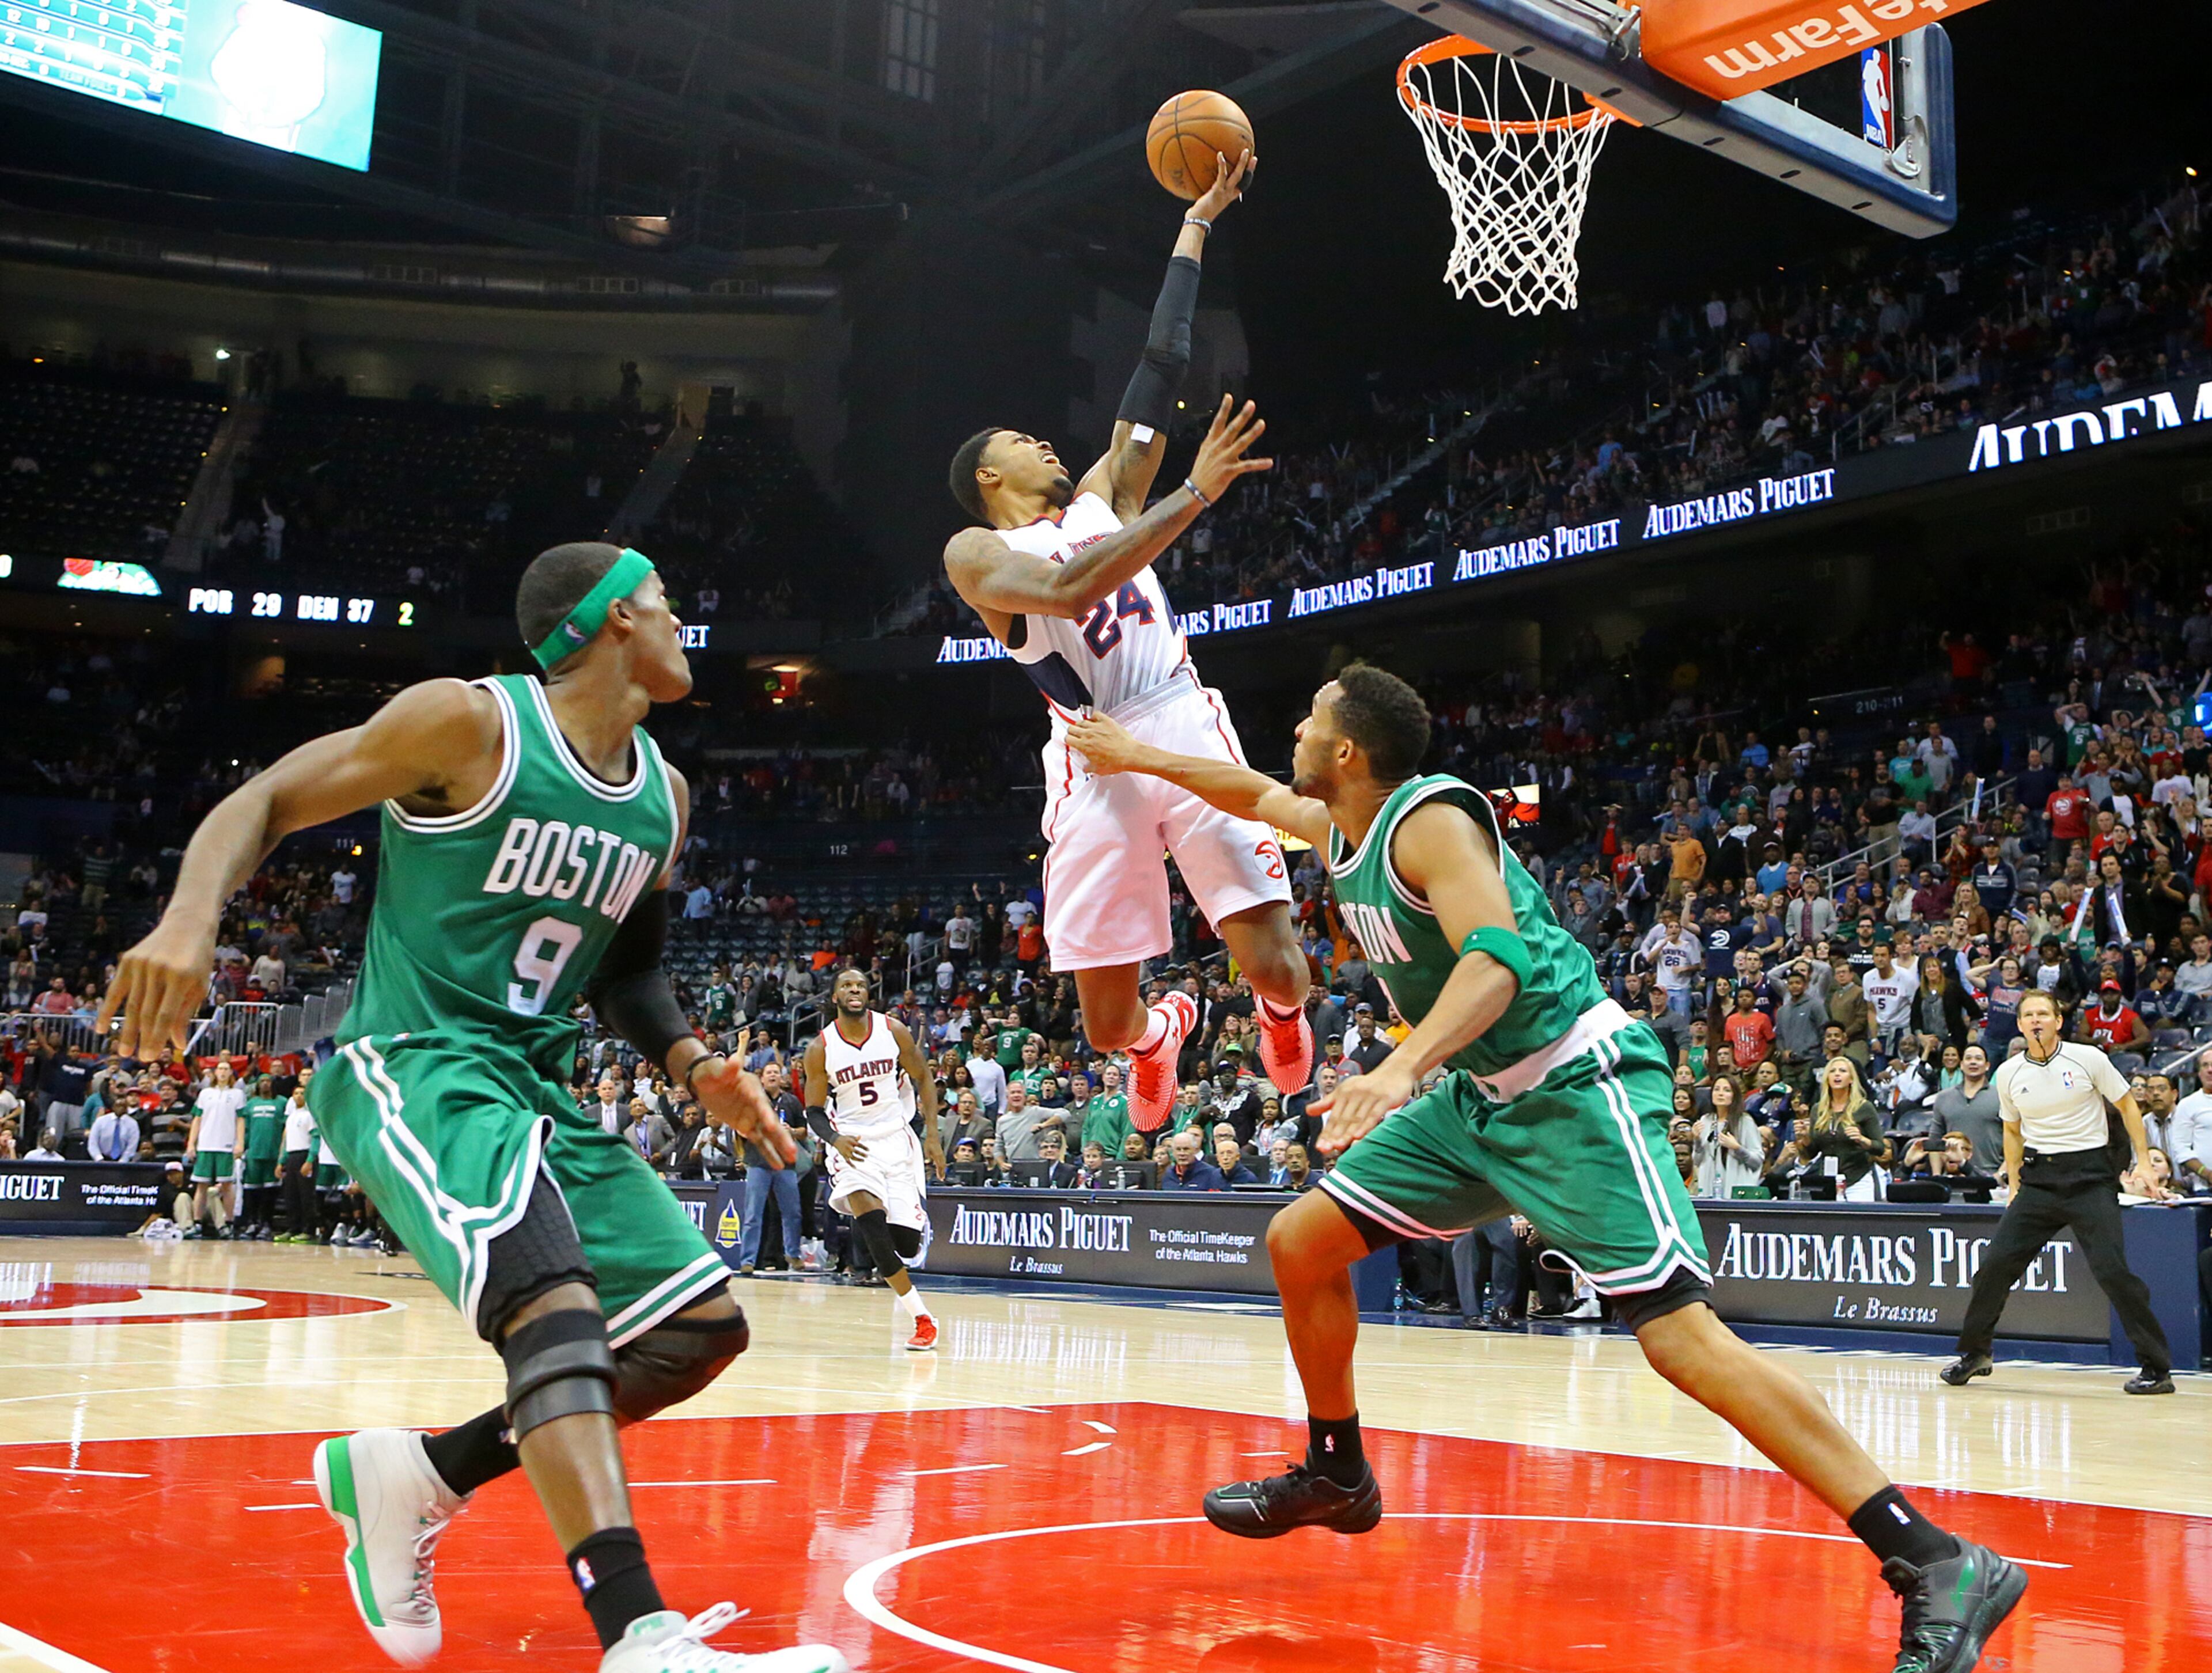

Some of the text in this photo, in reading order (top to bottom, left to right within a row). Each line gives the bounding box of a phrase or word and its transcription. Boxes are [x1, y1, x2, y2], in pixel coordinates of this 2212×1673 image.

[1642, 468, 1835, 538] AUDEMARS PIGUET
[1452, 518, 1620, 582] AUDEMARS PIGUET
[1288, 561, 1435, 619] AUDEMARS PIGUET
[188, 588, 233, 614] POR
[297, 594, 340, 621] DEN
[398, 602, 414, 626] 2
[1073, 578, 1157, 661] 24
[1213, 599, 1272, 632] PIGUET
[830, 844, 847, 855] 112
[482, 818, 657, 924] BOSTON
[507, 916, 583, 1016] 9
[1869, 986, 1898, 996] HAWKS
[1878, 998, 1886, 1010] 5
[1002, 1037, 1012, 1048] 9
[859, 1081, 878, 1106] 5
[81, 1184, 99, 1194] The
[949, 1204, 1132, 1251] AUDEMARS PIGUET
[1149, 1229, 1256, 1249] The Official TimeKeeper
[1009, 1255, 1063, 1274] Le Brassus
[1155, 1247, 1249, 1264] of the Atlanta Hawks
[1714, 1222, 1917, 1287] AUDEMARS
[1833, 1295, 1939, 1324] Le Brassus
